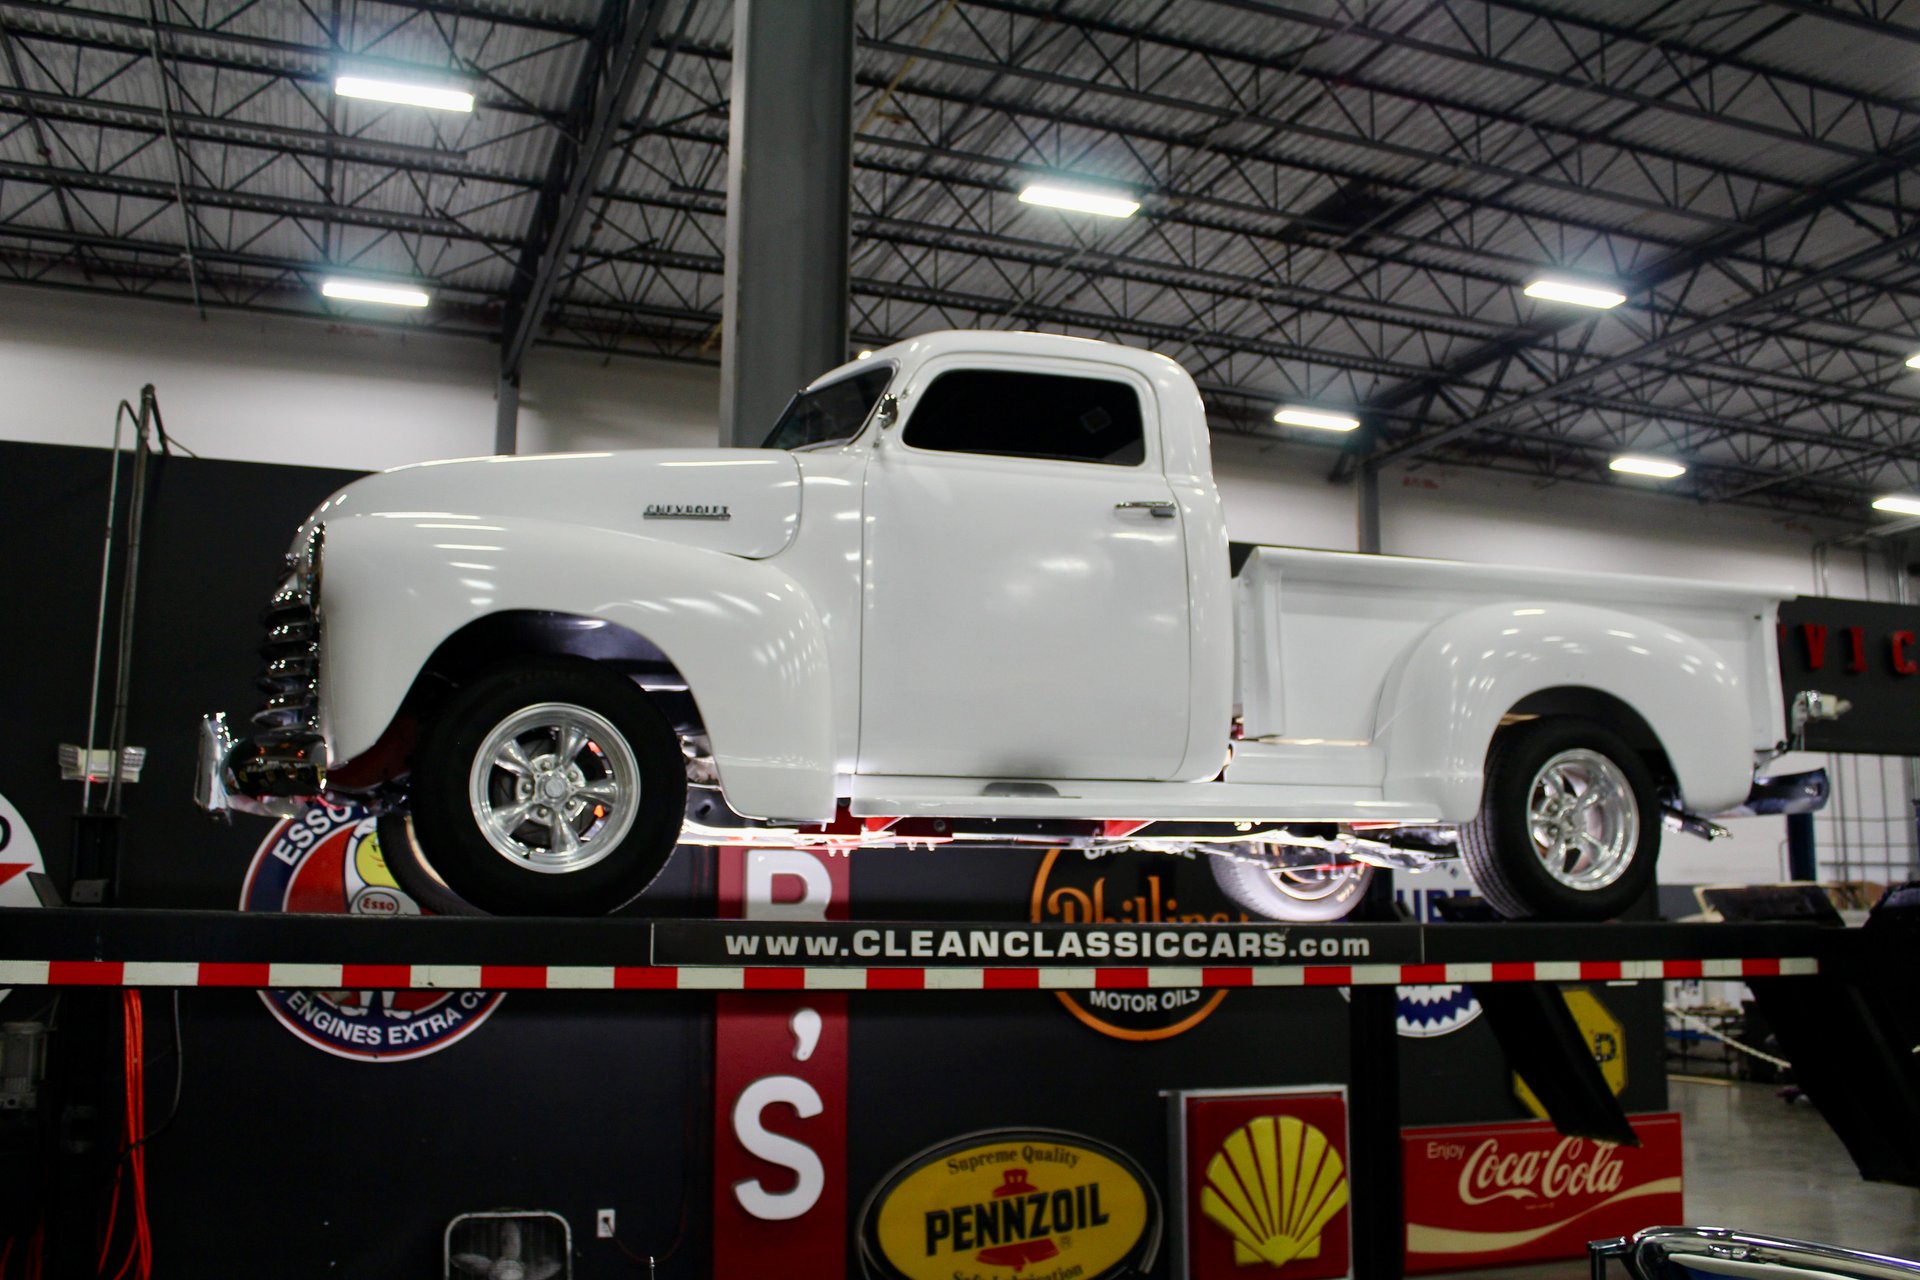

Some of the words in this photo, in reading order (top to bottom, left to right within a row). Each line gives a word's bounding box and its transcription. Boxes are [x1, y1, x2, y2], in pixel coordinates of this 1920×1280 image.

[646, 504, 729, 514] CHEVROLET
[1780, 623, 1918, 674] VIC
[272, 806, 352, 867] ESSO
[362, 898, 396, 912] Esso
[725, 929, 1370, 958] www.CLEANCLASSICCARS.com
[286, 991, 382, 1046] ENGINES
[388, 1006, 463, 1045] EXTRA
[1090, 990, 1158, 1012] MOTOR
[1161, 989, 1200, 1009] OILS
[946, 1150, 1018, 1175] Supreme
[1022, 1145, 1080, 1169] Quality
[1427, 1141, 1466, 1160] Enjoy
[1458, 1136, 1624, 1206] Coca-Cola
[924, 1182, 1110, 1257] PENNZOIL
